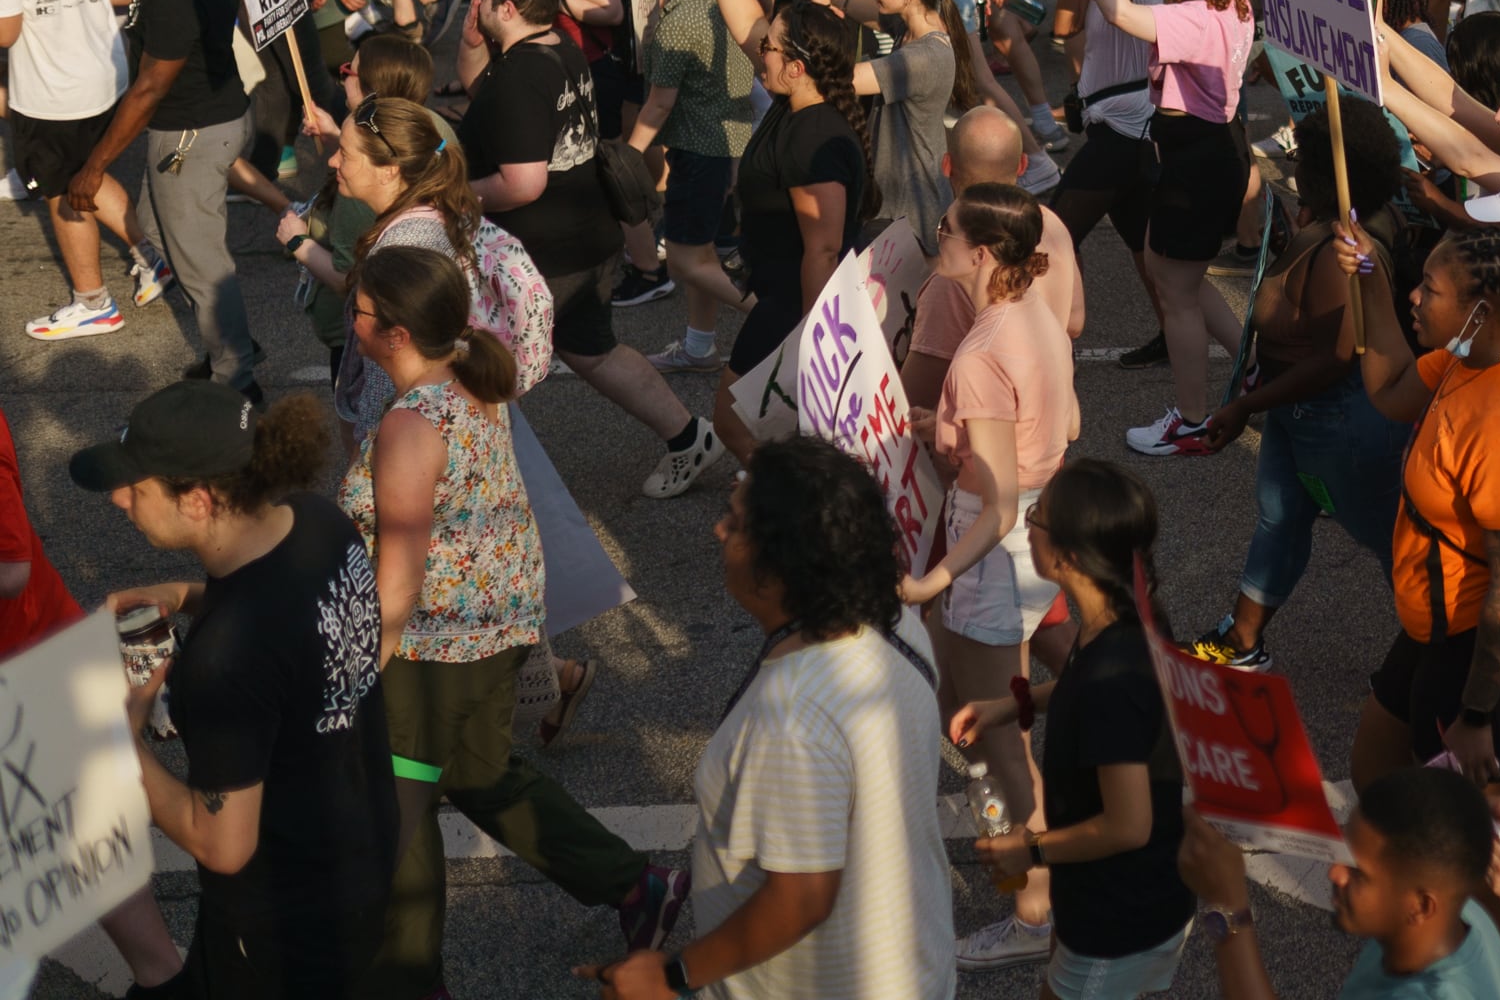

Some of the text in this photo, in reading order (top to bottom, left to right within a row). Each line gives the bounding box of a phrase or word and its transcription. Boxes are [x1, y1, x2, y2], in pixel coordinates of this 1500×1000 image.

[1285, 63, 1326, 99] FU
[1163, 656, 1226, 716] ONS
[1179, 730, 1261, 792] CARE
[25, 813, 132, 927] OPINION
